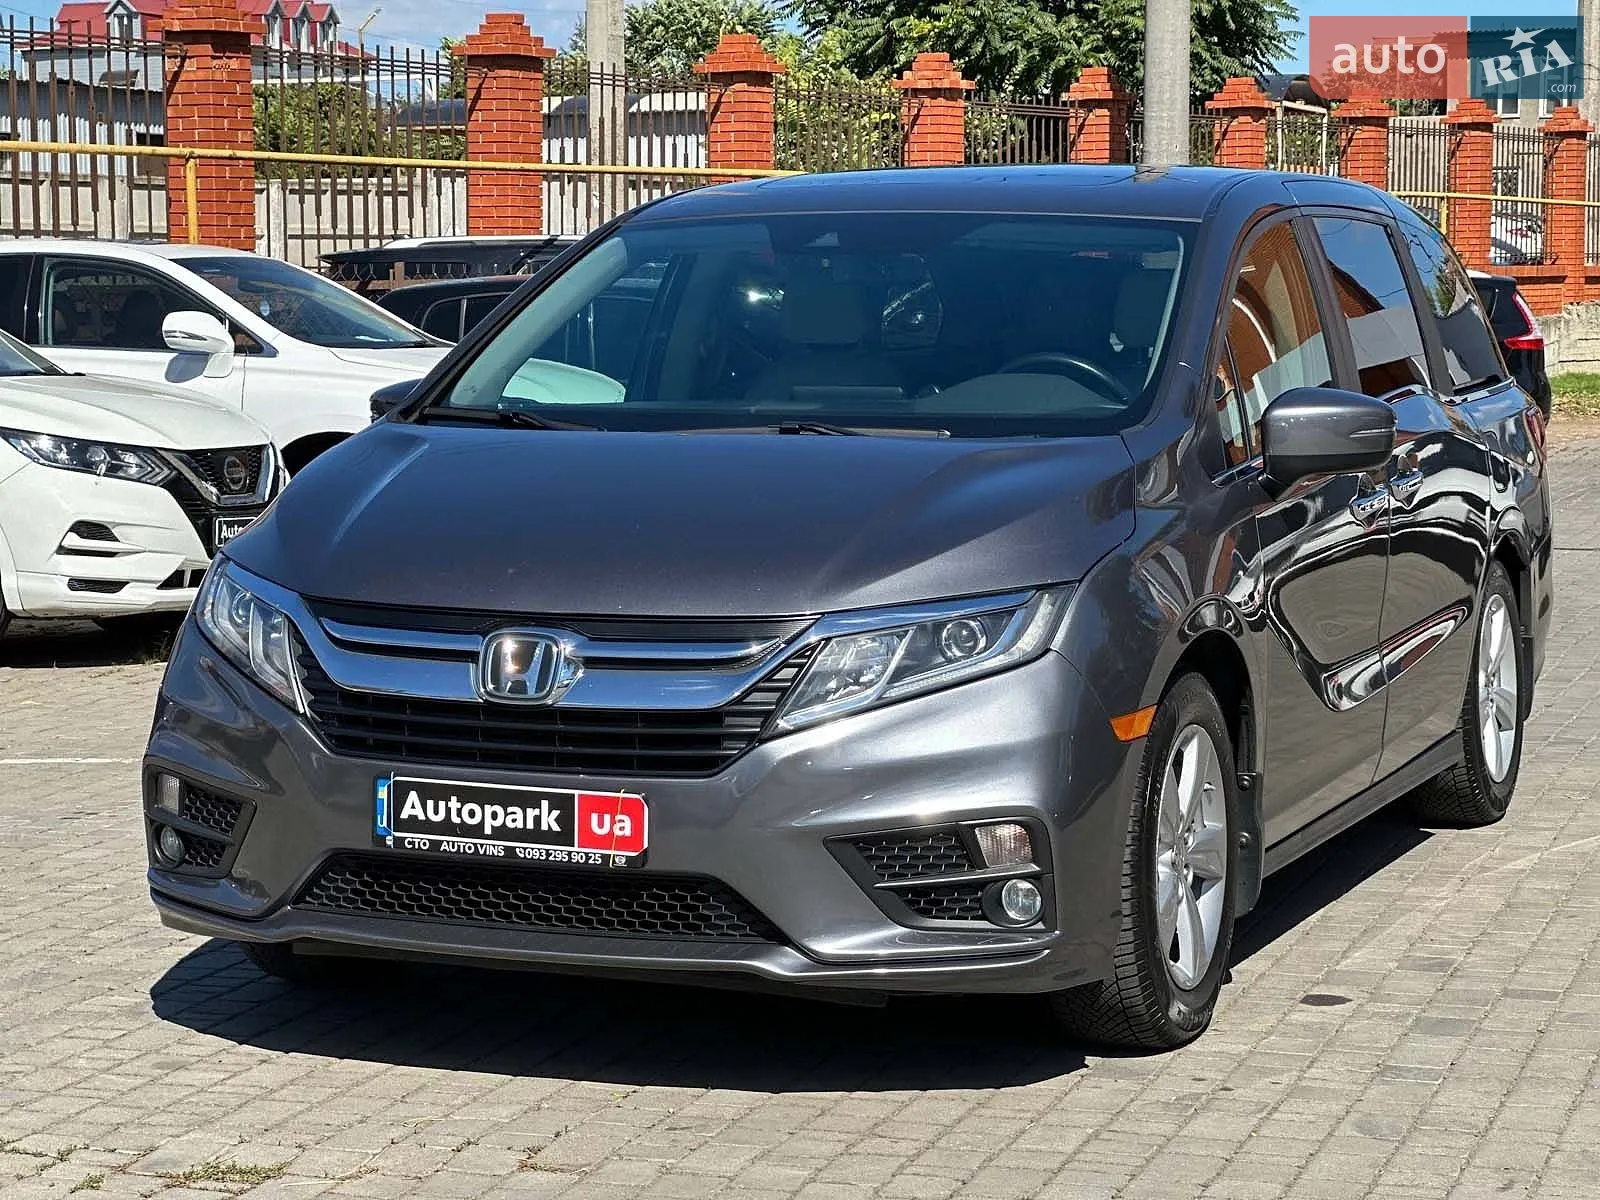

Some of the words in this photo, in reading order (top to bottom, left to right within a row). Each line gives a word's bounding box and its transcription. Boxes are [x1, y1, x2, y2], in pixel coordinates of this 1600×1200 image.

[400, 790, 562, 835] Autopark
[590, 812, 632, 837] ua
[440, 840, 475, 854] AUTO
[476, 843, 505, 857] VINS
[525, 848, 547, 860] 093
[548, 851, 569, 862] 295
[570, 853, 586, 863] 90
[587, 854, 603, 865] 25
